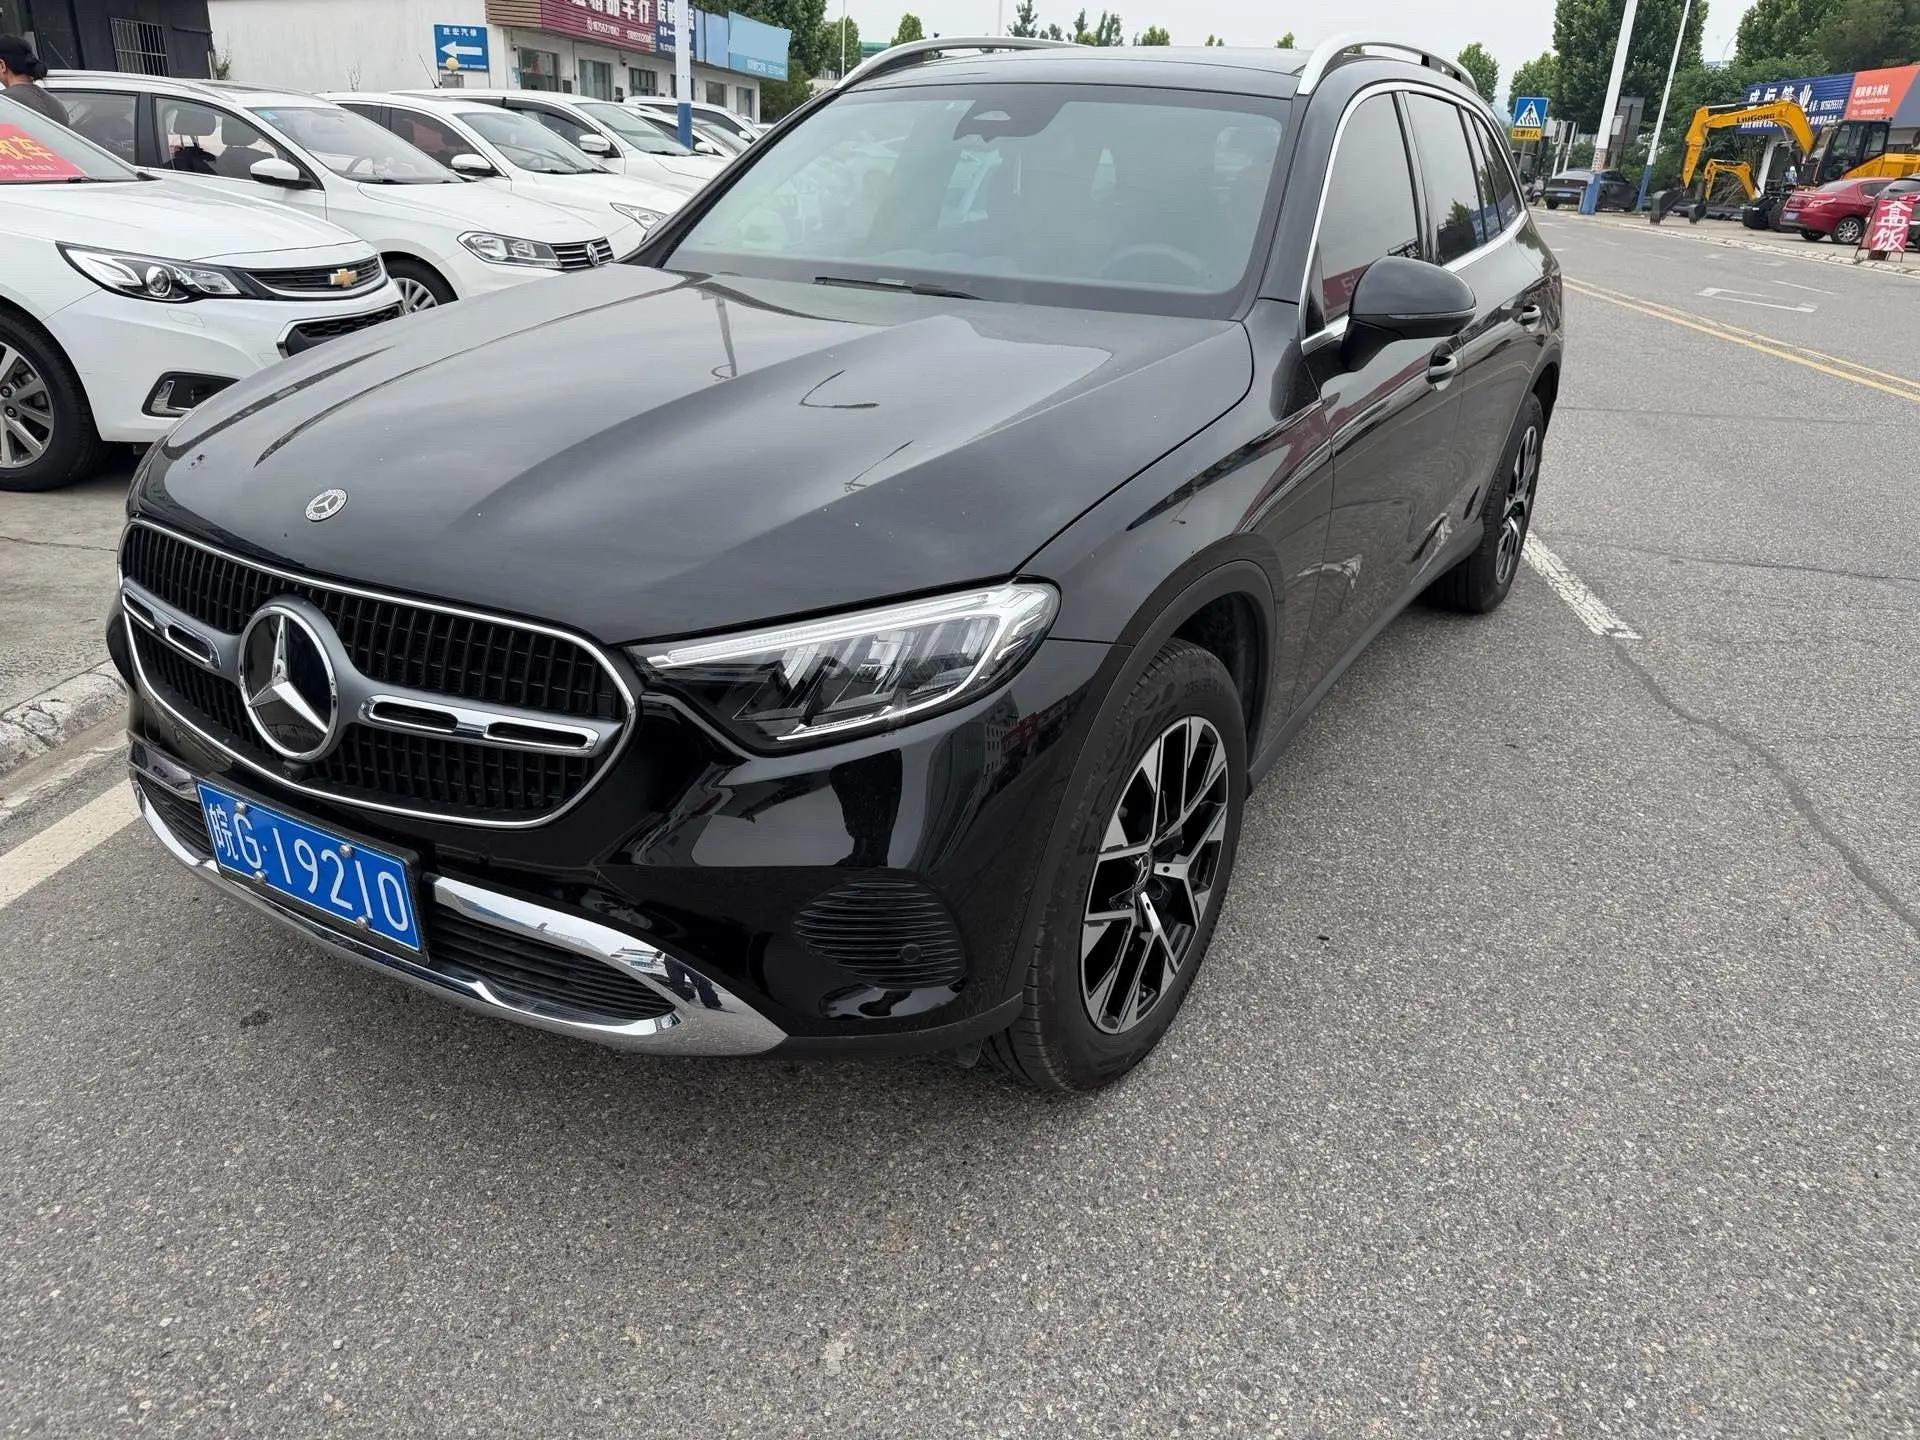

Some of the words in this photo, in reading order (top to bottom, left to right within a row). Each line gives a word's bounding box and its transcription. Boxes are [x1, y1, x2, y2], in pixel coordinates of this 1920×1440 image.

[1513, 129, 1539, 138] 注意行人
[1872, 200, 1912, 252] 盒饭
